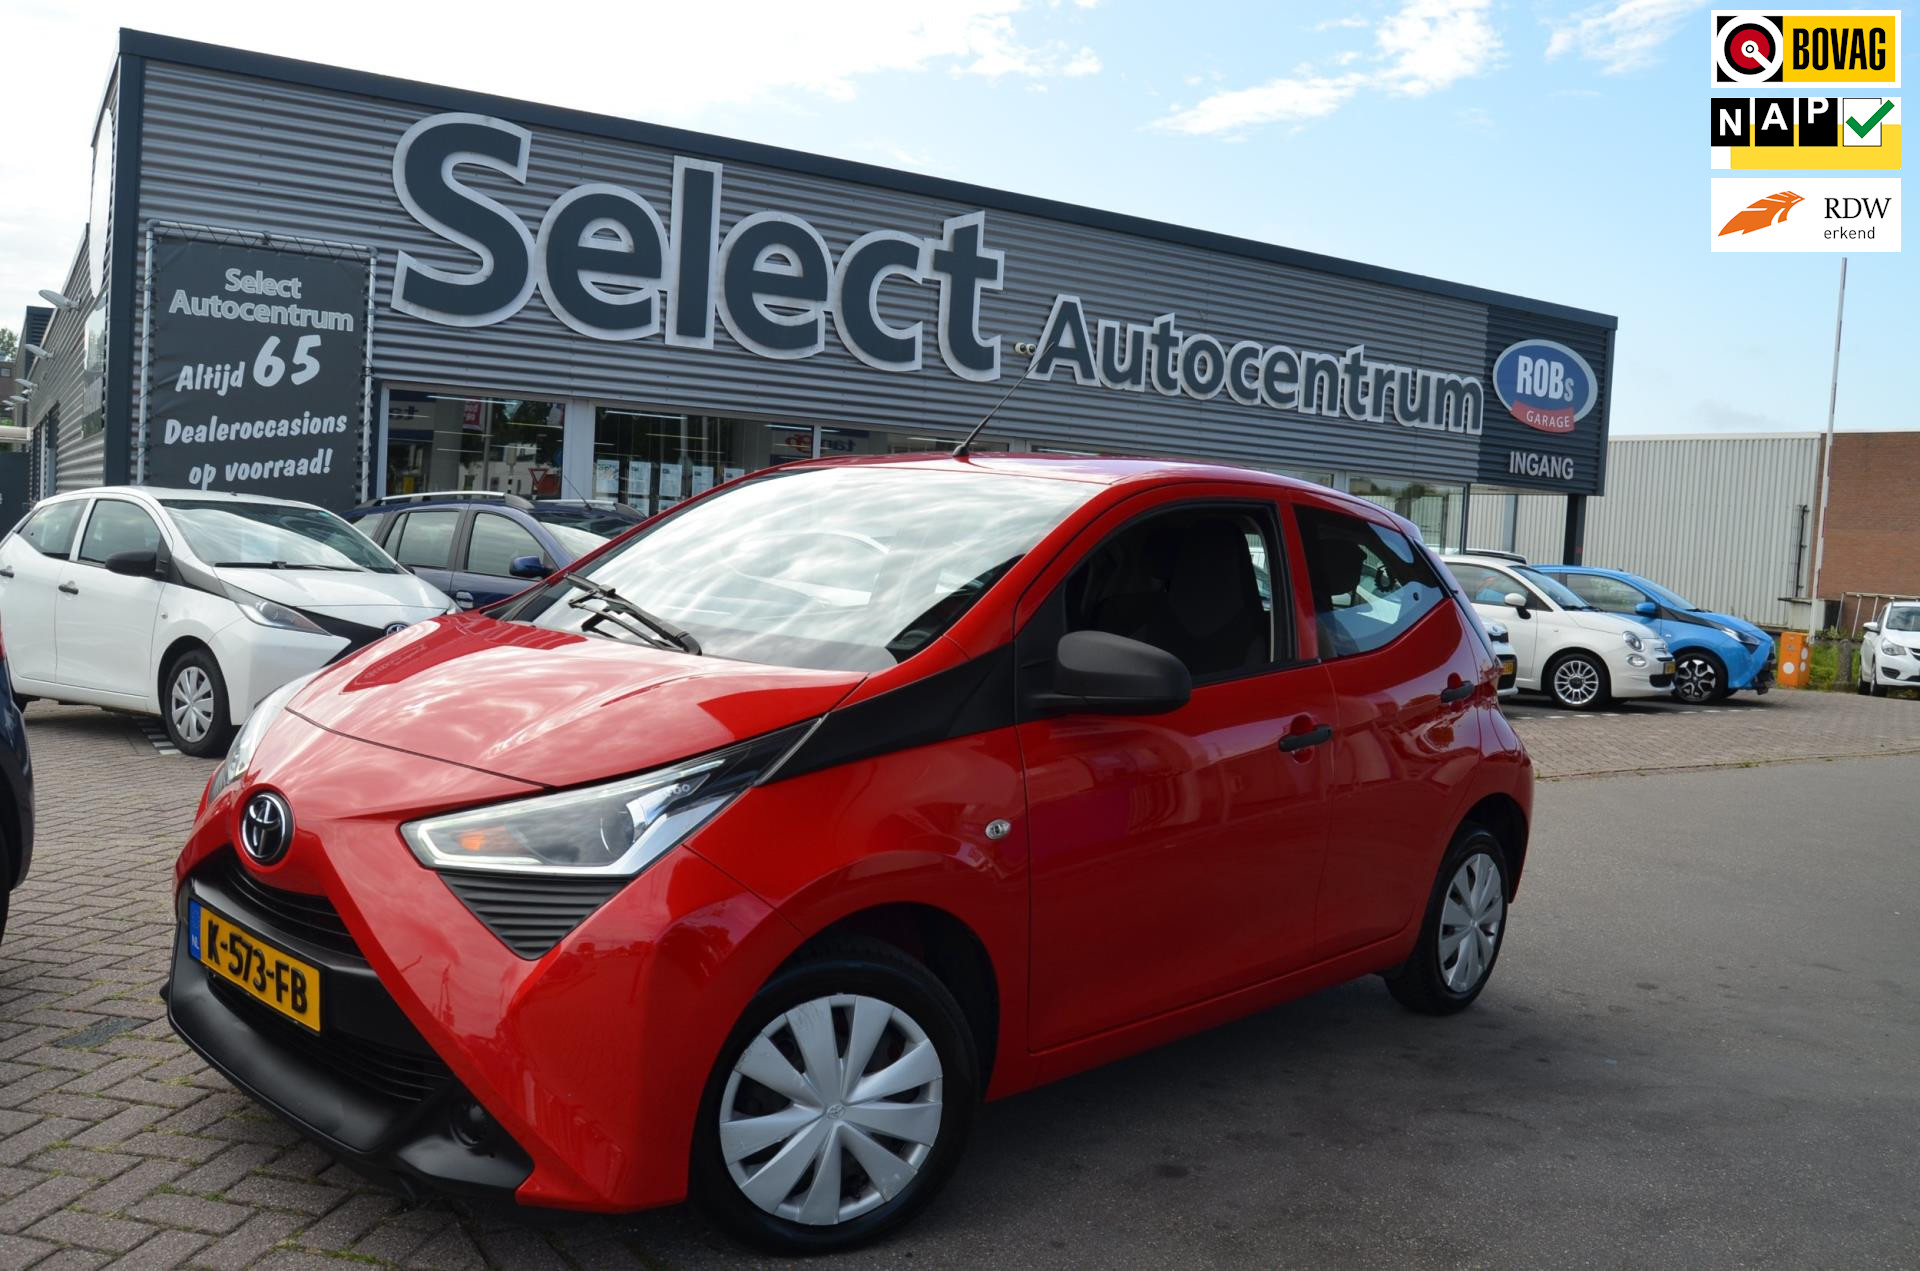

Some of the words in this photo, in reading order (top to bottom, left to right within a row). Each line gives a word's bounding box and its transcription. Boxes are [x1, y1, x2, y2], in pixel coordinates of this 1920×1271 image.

[391, 112, 1004, 381] Select
[224, 267, 302, 299] Select
[168, 289, 354, 332] Autocentrum
[175, 361, 246, 397] Altijd
[252, 334, 322, 388] 65
[1026, 294, 1484, 436] Autocentrum
[1516, 354, 1575, 402] ROBs
[164, 410, 348, 445] Dealeroccasions
[1526, 410, 1571, 429] GARAGE
[188, 463, 217, 491] op
[225, 448, 334, 482] voorraad!
[1508, 450, 1575, 480] INGANG
[207, 919, 308, 1015] K-573-FB
